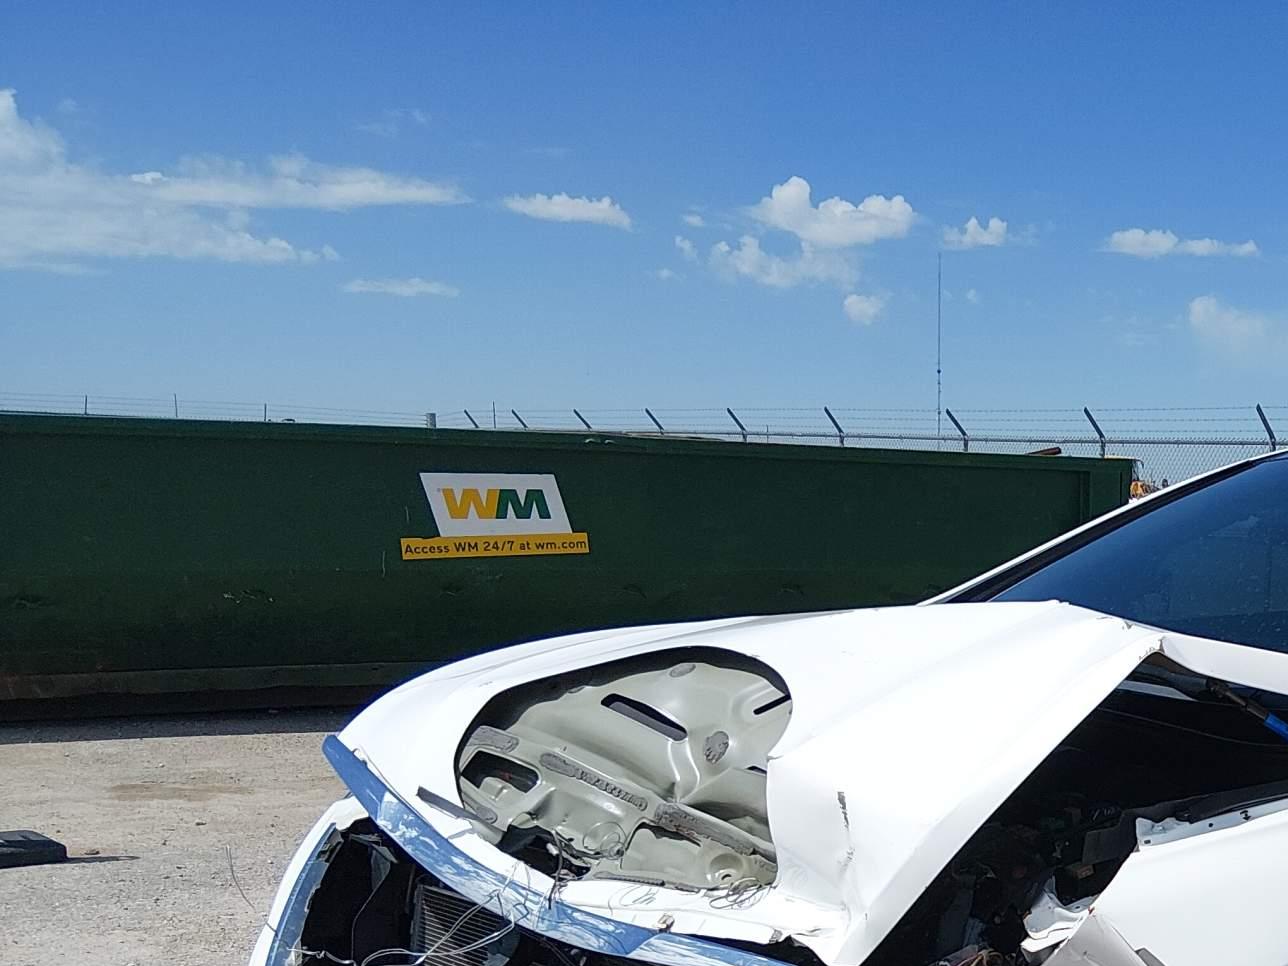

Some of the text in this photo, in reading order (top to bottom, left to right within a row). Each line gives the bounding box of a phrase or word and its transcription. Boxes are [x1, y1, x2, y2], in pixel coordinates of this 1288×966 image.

[441, 488, 551, 519] WM
[404, 540, 587, 554] Access WM 24/7 at wm.com
